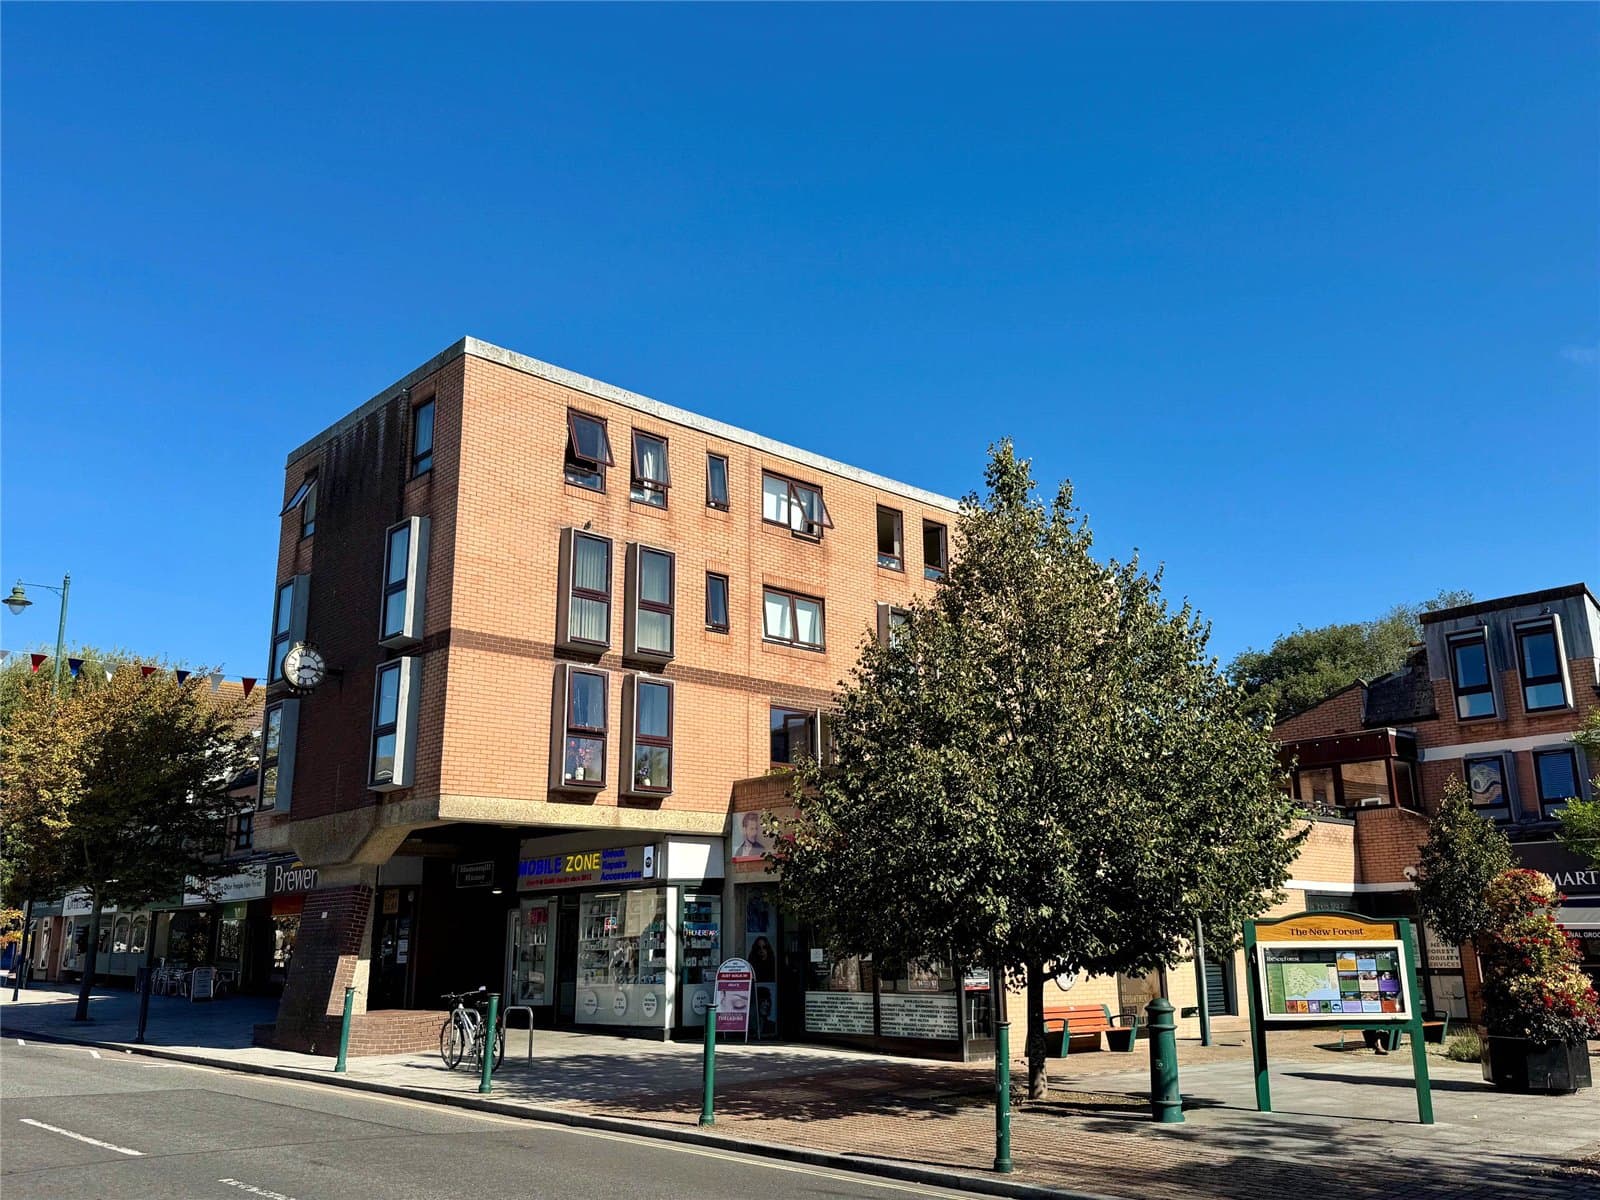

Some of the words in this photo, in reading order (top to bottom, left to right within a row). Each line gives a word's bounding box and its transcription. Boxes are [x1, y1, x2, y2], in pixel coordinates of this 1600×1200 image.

[518, 857, 562, 877] MOBILE
[565, 853, 600, 873] ZONE
[600, 869, 642, 881] Accessories
[1290, 927, 1308, 937] The
[1309, 927, 1331, 936] New
[1332, 927, 1364, 936] Forest
